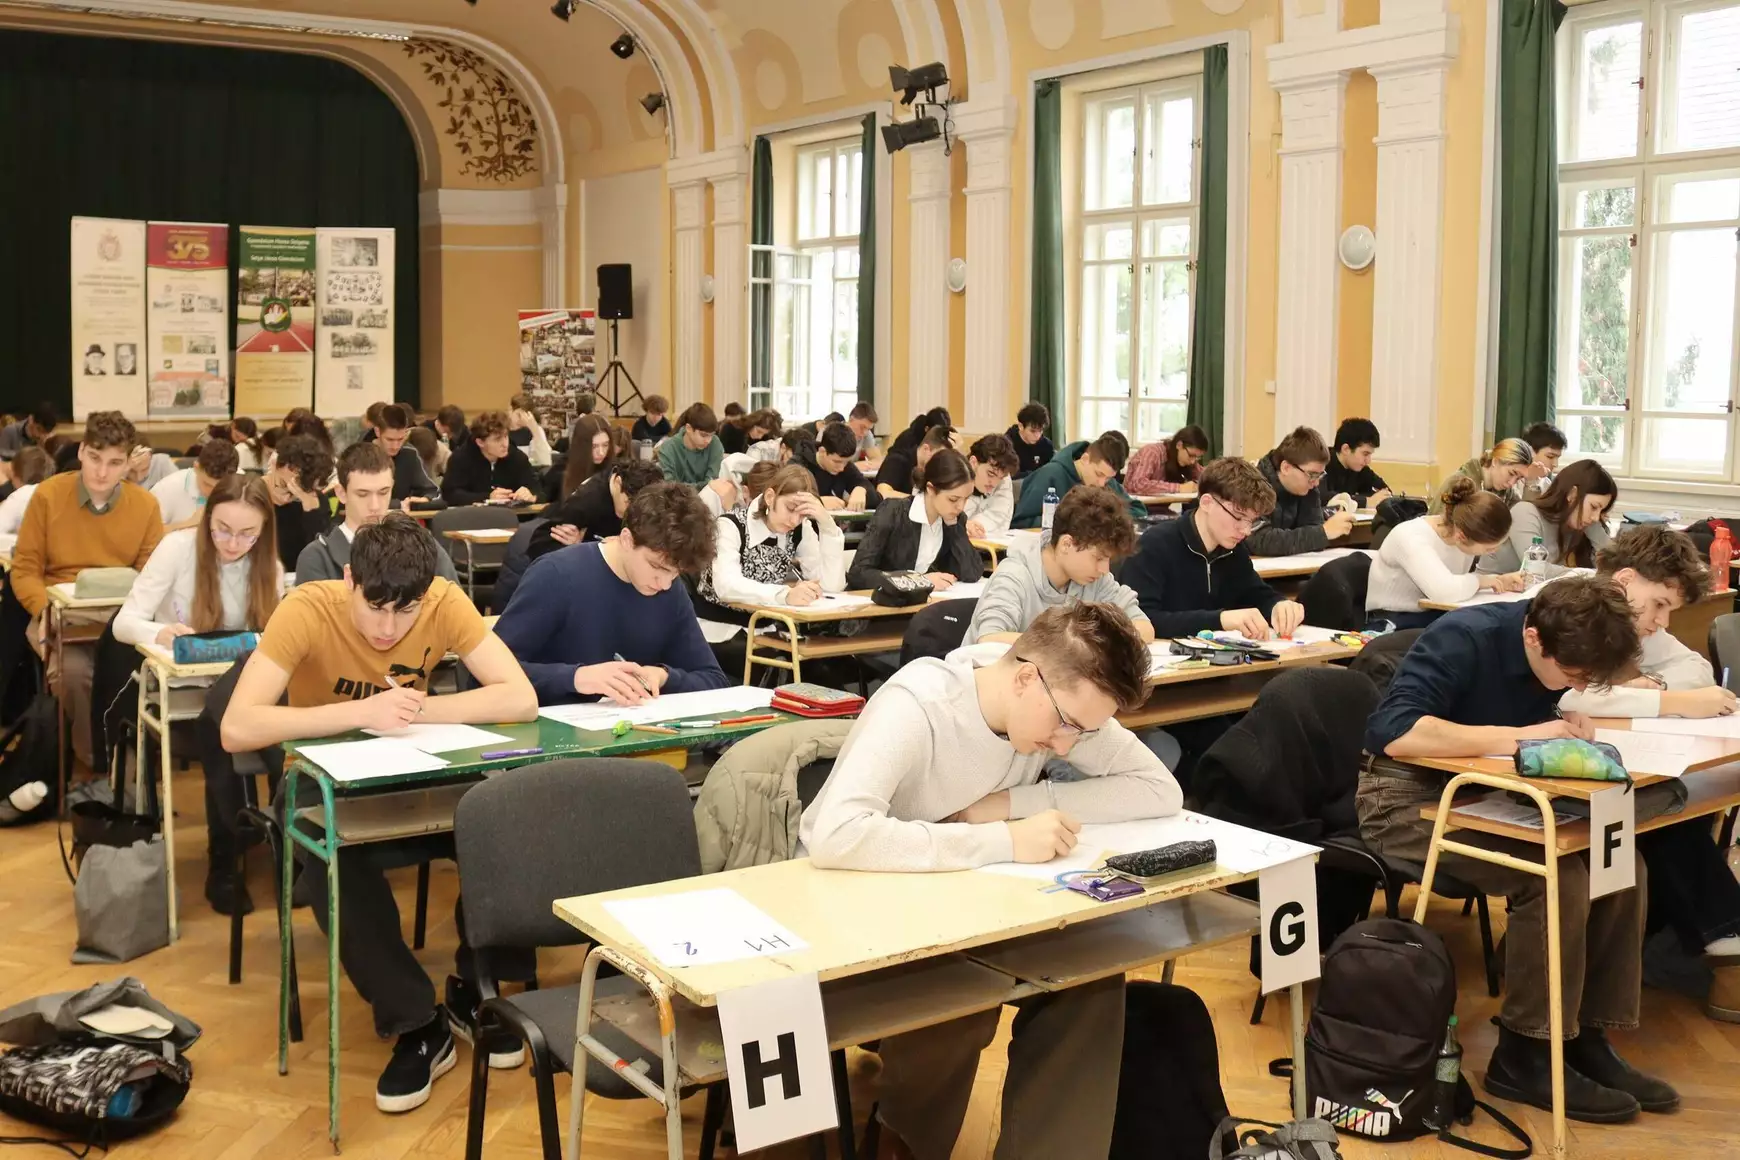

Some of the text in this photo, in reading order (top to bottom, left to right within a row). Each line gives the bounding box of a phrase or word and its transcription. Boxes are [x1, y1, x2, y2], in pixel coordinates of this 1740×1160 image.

[1603, 820, 1624, 869] F
[1269, 901, 1306, 957] G
[741, 1031, 802, 1110] H
[1314, 1096, 1391, 1137] PUMA
